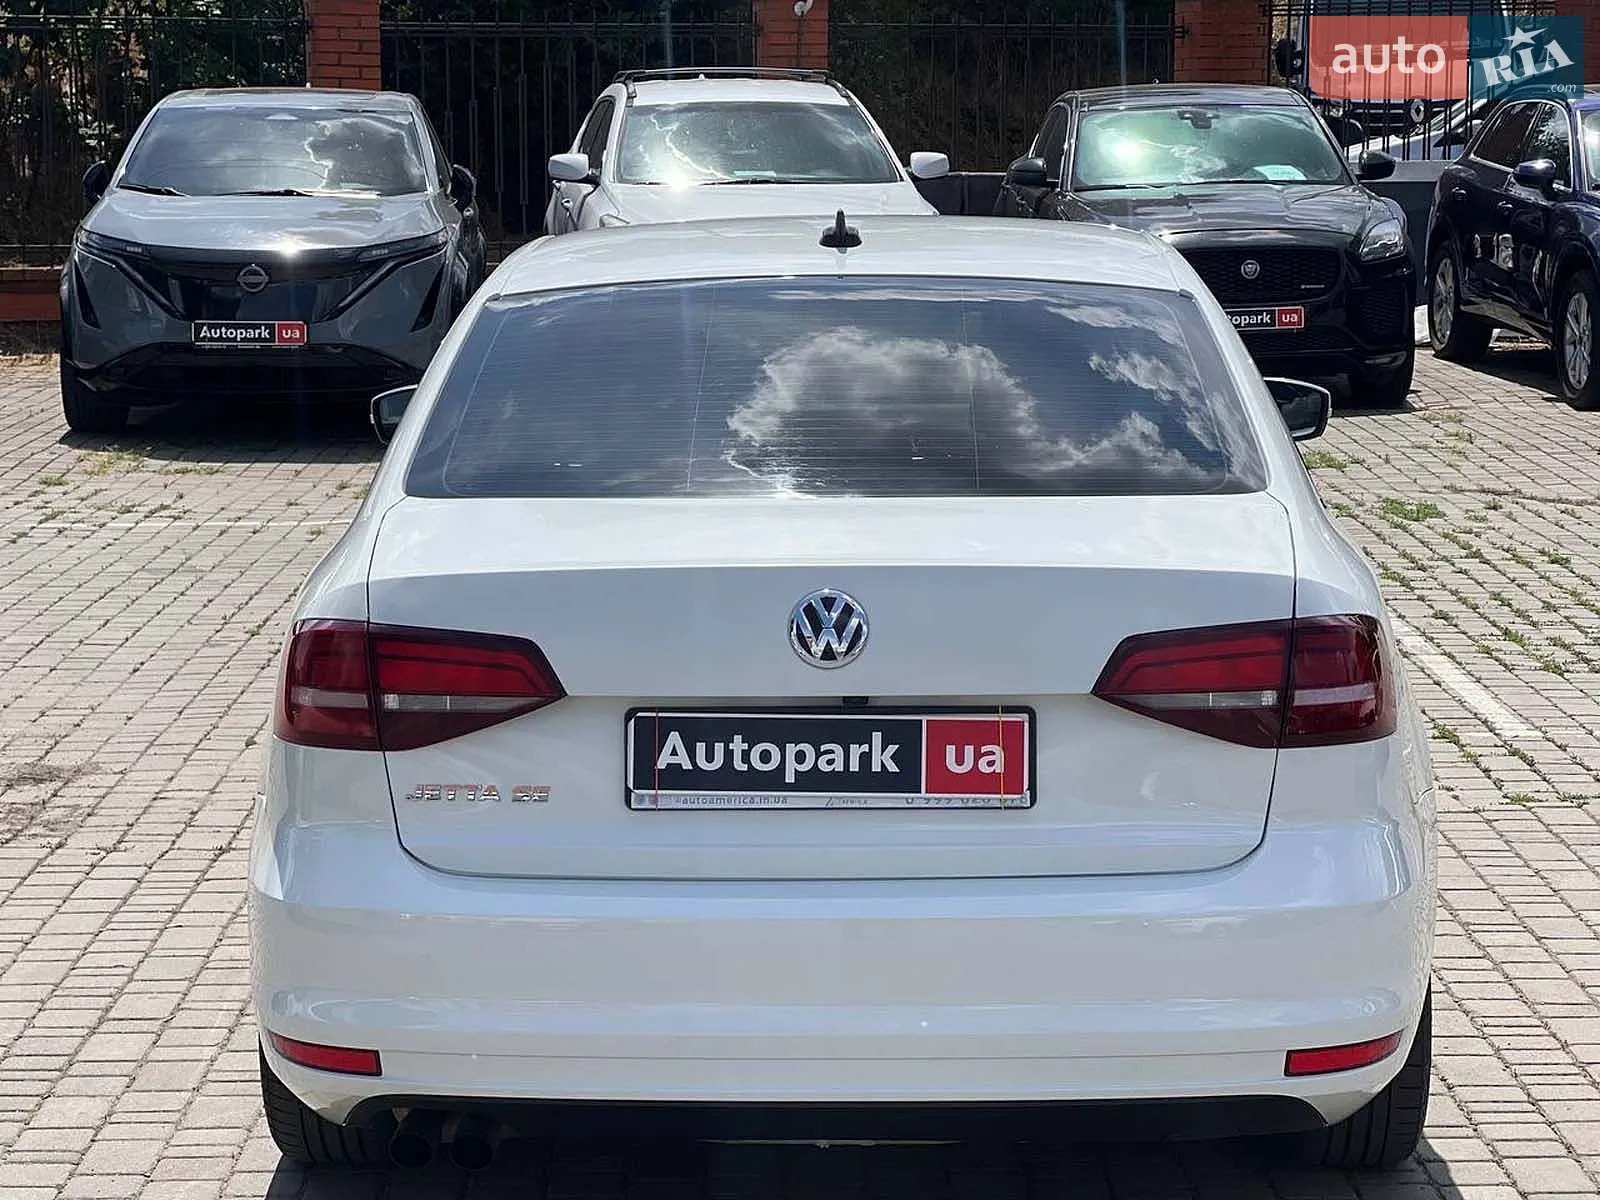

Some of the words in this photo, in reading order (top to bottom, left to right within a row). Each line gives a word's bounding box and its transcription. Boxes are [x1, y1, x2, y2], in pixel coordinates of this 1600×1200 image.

[1282, 313, 1298, 322] ua
[199, 326, 270, 341] Autopark
[282, 329, 300, 338] ua
[656, 731, 900, 784] Autopark
[944, 742, 1005, 775] ua
[405, 784, 501, 801] JETTA
[511, 784, 551, 802] SE
